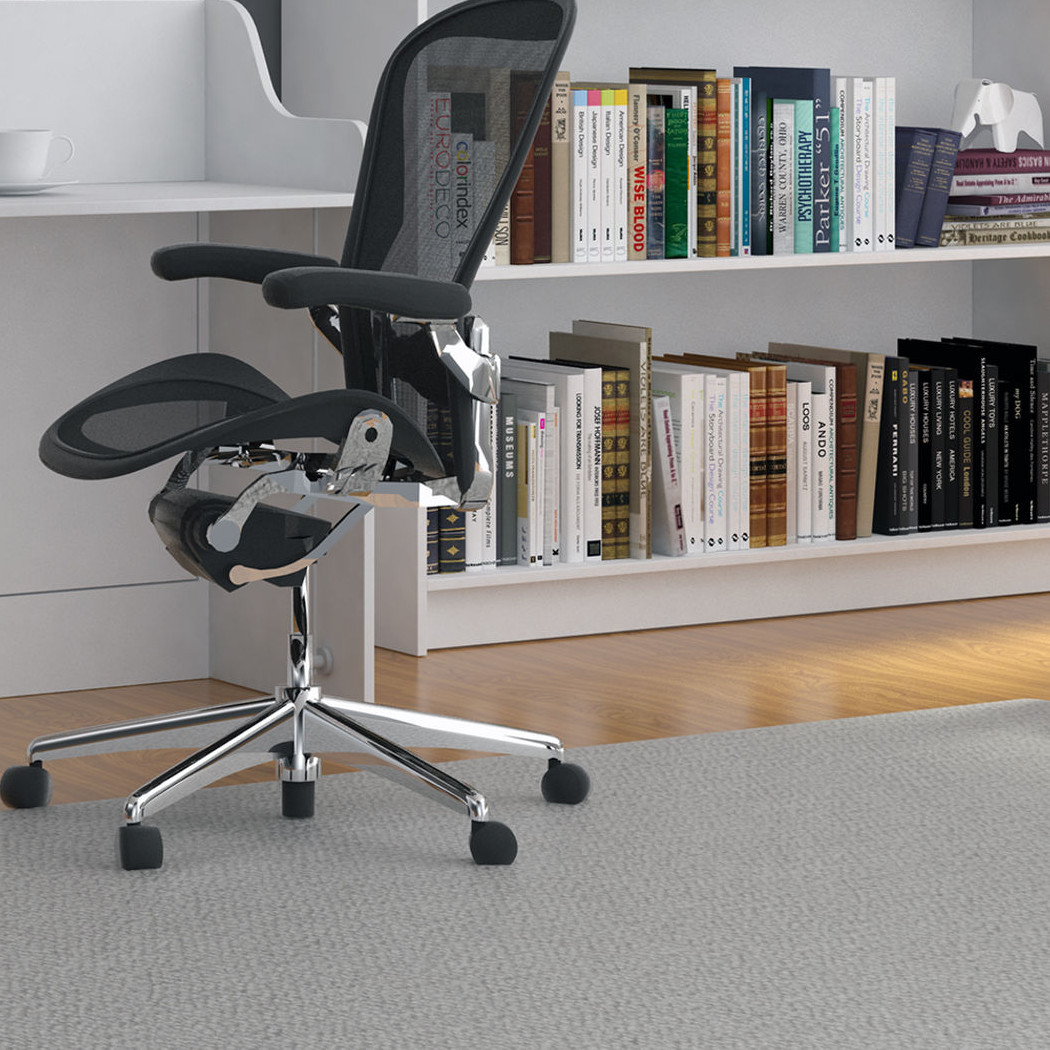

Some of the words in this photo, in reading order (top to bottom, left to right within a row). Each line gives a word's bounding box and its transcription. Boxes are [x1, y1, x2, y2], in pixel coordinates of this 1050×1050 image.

[779, 122, 788, 146] OHIO
[435, 97, 451, 239] EURODECO
[779, 149, 788, 190] COUNTY,
[798, 129, 812, 222] PSYCHOTHERAPY
[993, 157, 1017, 169] SAFETY
[1018, 156, 1043, 168] BASICS
[456, 141, 472, 229] colorindex
[634, 166, 645, 202] WISE
[998, 195, 1014, 204] The
[779, 193, 788, 233] WARREN
[815, 161, 830, 247] Parker
[634, 205, 645, 252] BLOOD
[950, 222, 990, 230] VIOLETS
[992, 221, 1010, 229] ARE
[969, 233, 1007, 243] Heritage
[1014, 388, 1021, 399] my
[964, 409, 972, 434] COOL
[505, 416, 514, 479] MUSEUMS
[818, 420, 826, 457] ANDO
[964, 436, 972, 463] GUIDE
[964, 466, 972, 497] London
